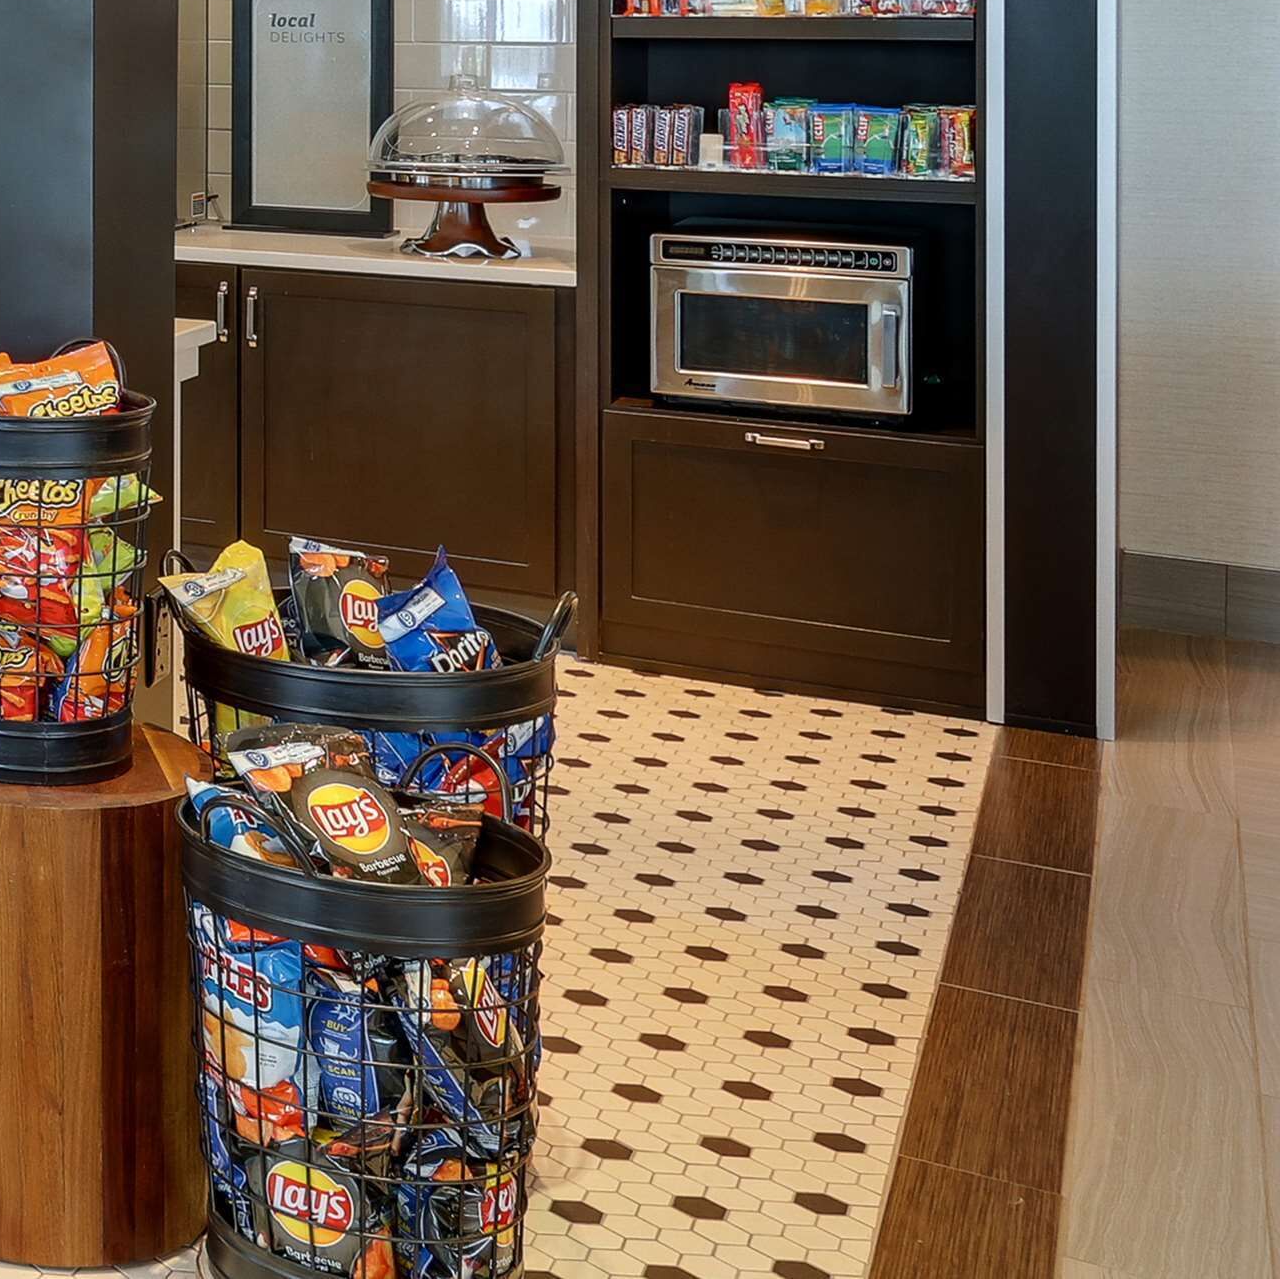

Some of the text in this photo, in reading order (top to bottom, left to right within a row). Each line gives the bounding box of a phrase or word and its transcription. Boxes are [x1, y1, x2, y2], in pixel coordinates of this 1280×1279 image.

[270, 13, 316, 28] local
[270, 31, 346, 44] DELIGHTS
[10, 508, 58, 523] Crunhy
[235, 616, 280, 657] Lay's
[358, 652, 389, 665] Barbecu
[431, 631, 489, 673] Dorito
[313, 795, 379, 838] Lay's
[358, 852, 407, 873] Barbecue
[326, 1019, 348, 1033] BUY
[327, 1065, 356, 1077] SCAN
[273, 1174, 347, 1224] Lay's
[284, 1245, 342, 1270] Barecue
